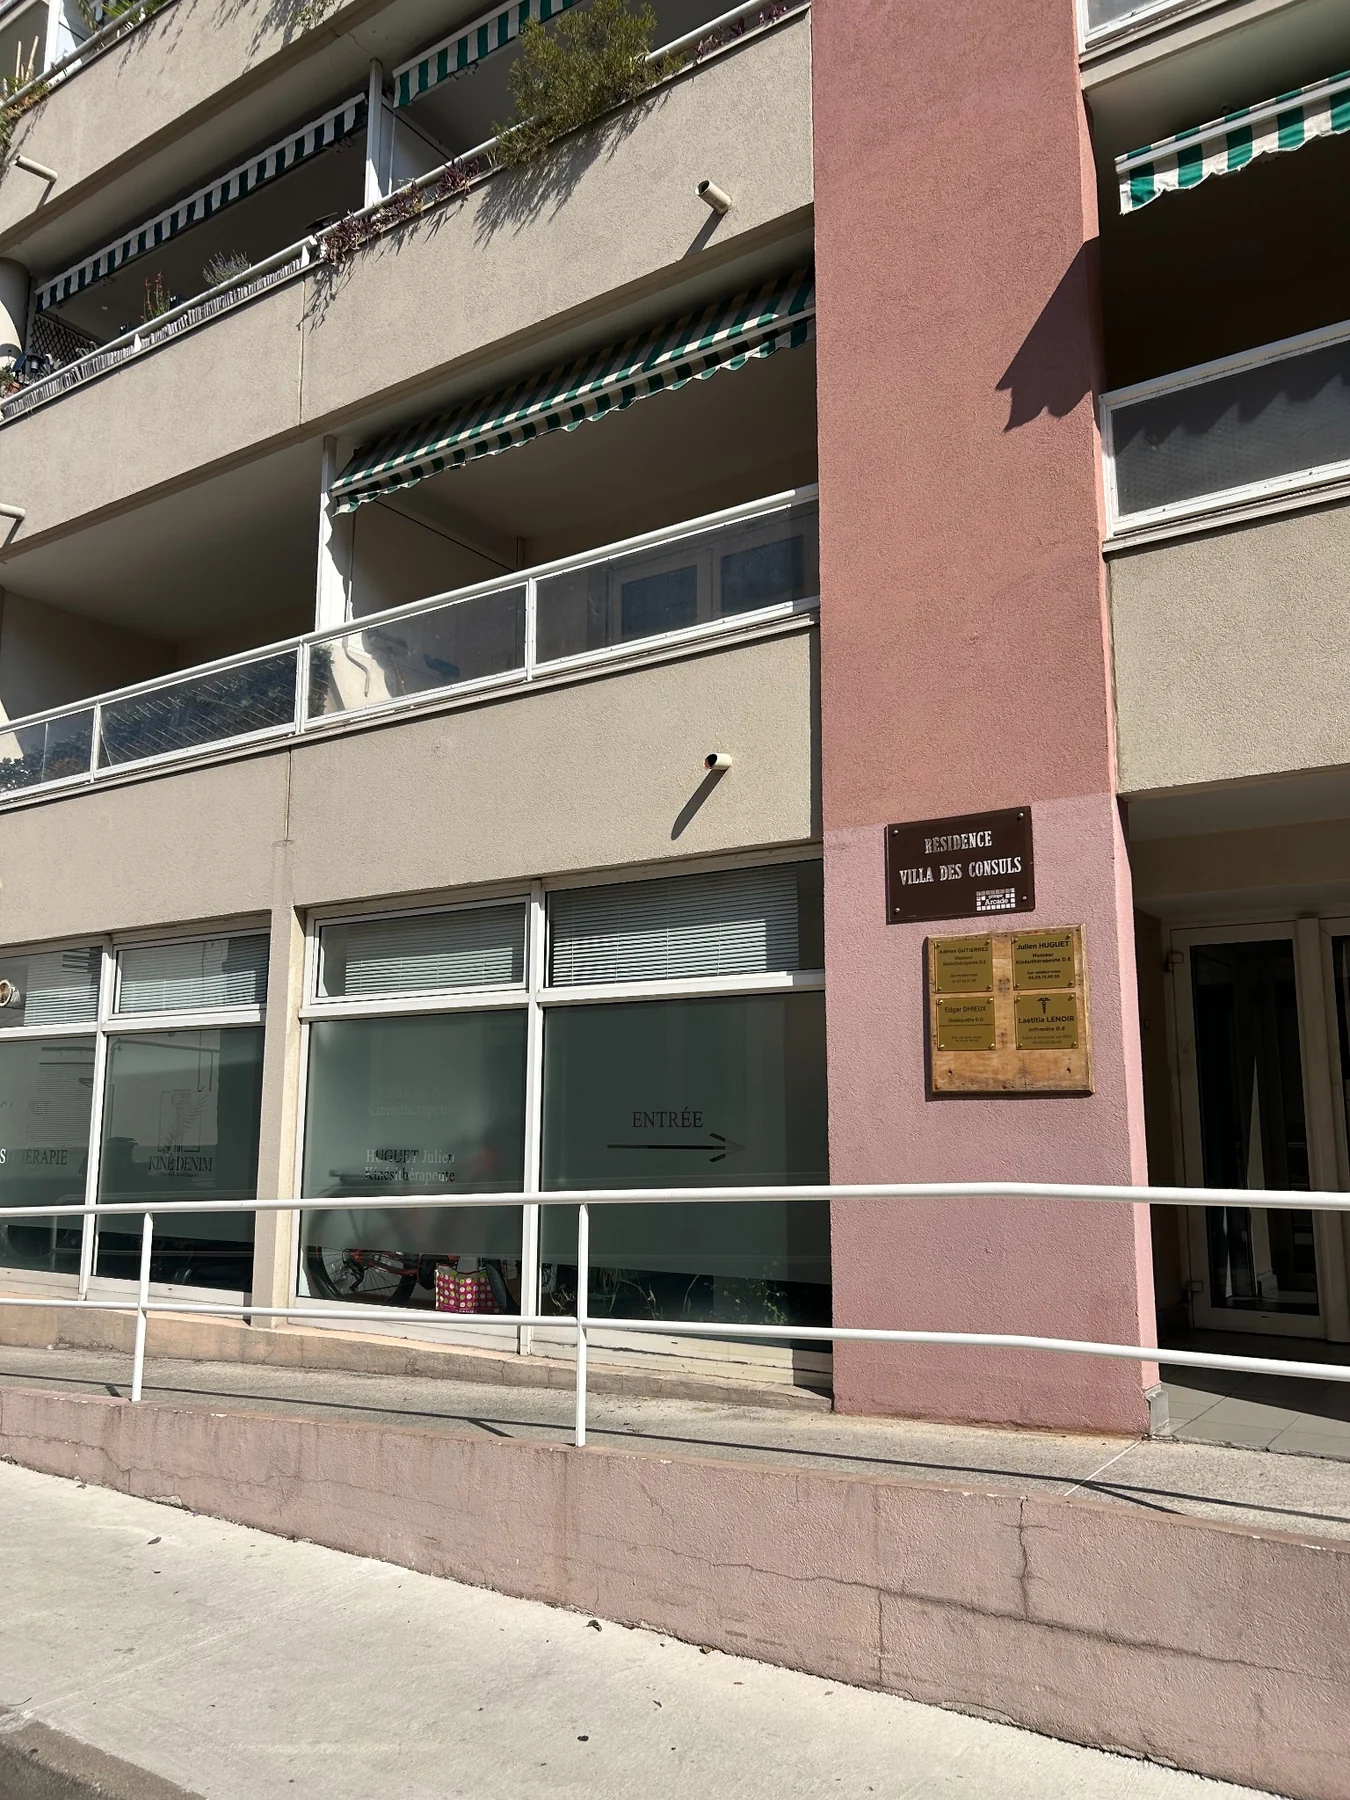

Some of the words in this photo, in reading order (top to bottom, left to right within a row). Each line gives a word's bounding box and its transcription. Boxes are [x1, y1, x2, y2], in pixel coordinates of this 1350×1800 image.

[924, 830, 993, 854] RESIDENCE
[899, 866, 935, 885] VILLA
[939, 863, 963, 881] DES
[968, 856, 1022, 878] CONSULS
[984, 897, 1009, 906] Arcade
[1038, 940, 1070, 949] HUGUET
[944, 1006, 962, 1014] Edgar
[1046, 1015, 1075, 1023] LENOIR
[631, 1106, 704, 1128] ENTRÉE
[148, 1153, 174, 1171] KINÉ
[176, 1155, 213, 1172] DENIM
[365, 1148, 419, 1163] HUGUET
[421, 1148, 456, 1164] Julien
[364, 1166, 456, 1186] Kinésithérapeute
